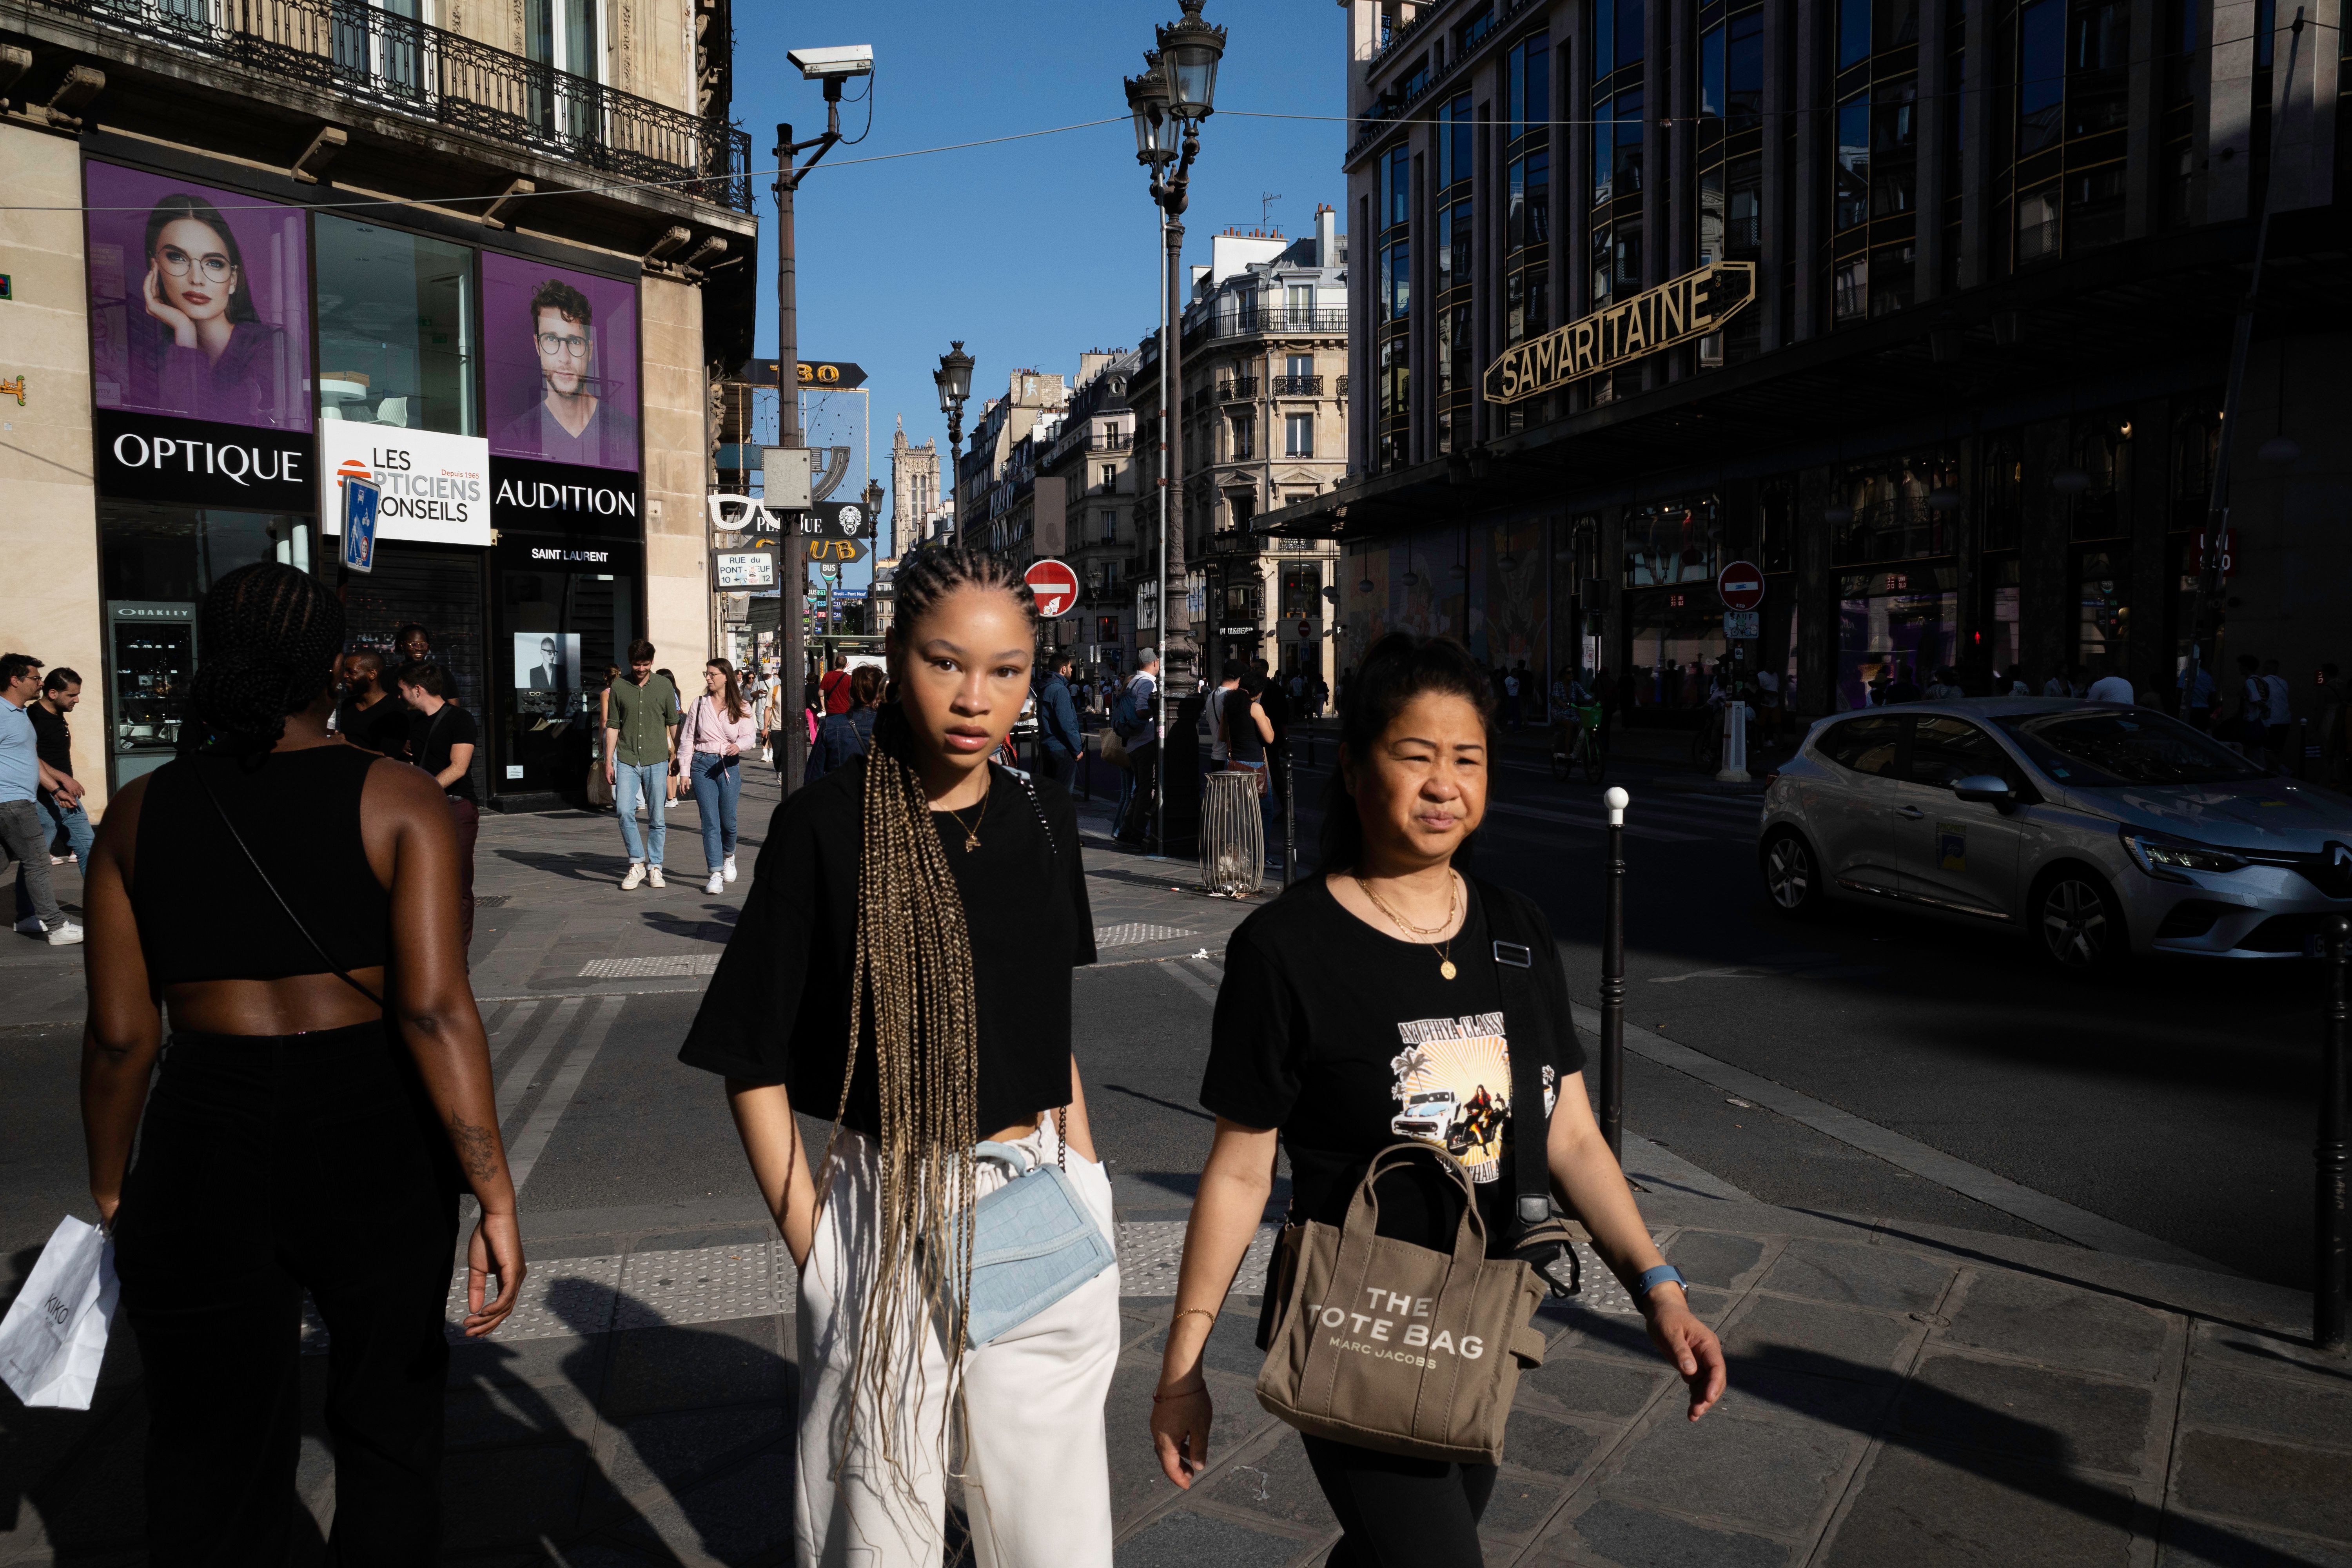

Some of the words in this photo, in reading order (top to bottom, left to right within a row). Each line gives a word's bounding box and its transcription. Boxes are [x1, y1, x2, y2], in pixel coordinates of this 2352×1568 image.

[1503, 270, 1712, 397] SAMARITAINE
[114, 434, 303, 486] OPTIQUE
[373, 447, 411, 470] LES
[441, 469, 463, 479] Depuis
[378, 496, 468, 522] ONSEILS
[496, 479, 635, 517] AUDITION
[362, 544, 367, 553] 20
[532, 548, 561, 560] SAINT
[563, 549, 608, 562] LAURENT
[756, 539, 855, 560] UB
[1940, 822, 1967, 833] PROPRETÉ
[1398, 1019, 1461, 1043] AYUTHYA
[44, 1293, 68, 1324] KIKO
[1367, 1287, 1433, 1317] THE
[1307, 1303, 1393, 1342] TOTE
[1403, 1324, 1484, 1359] BAG
[1329, 1337, 1370, 1354] MARC
[1375, 1349, 1437, 1370] JACOBS
